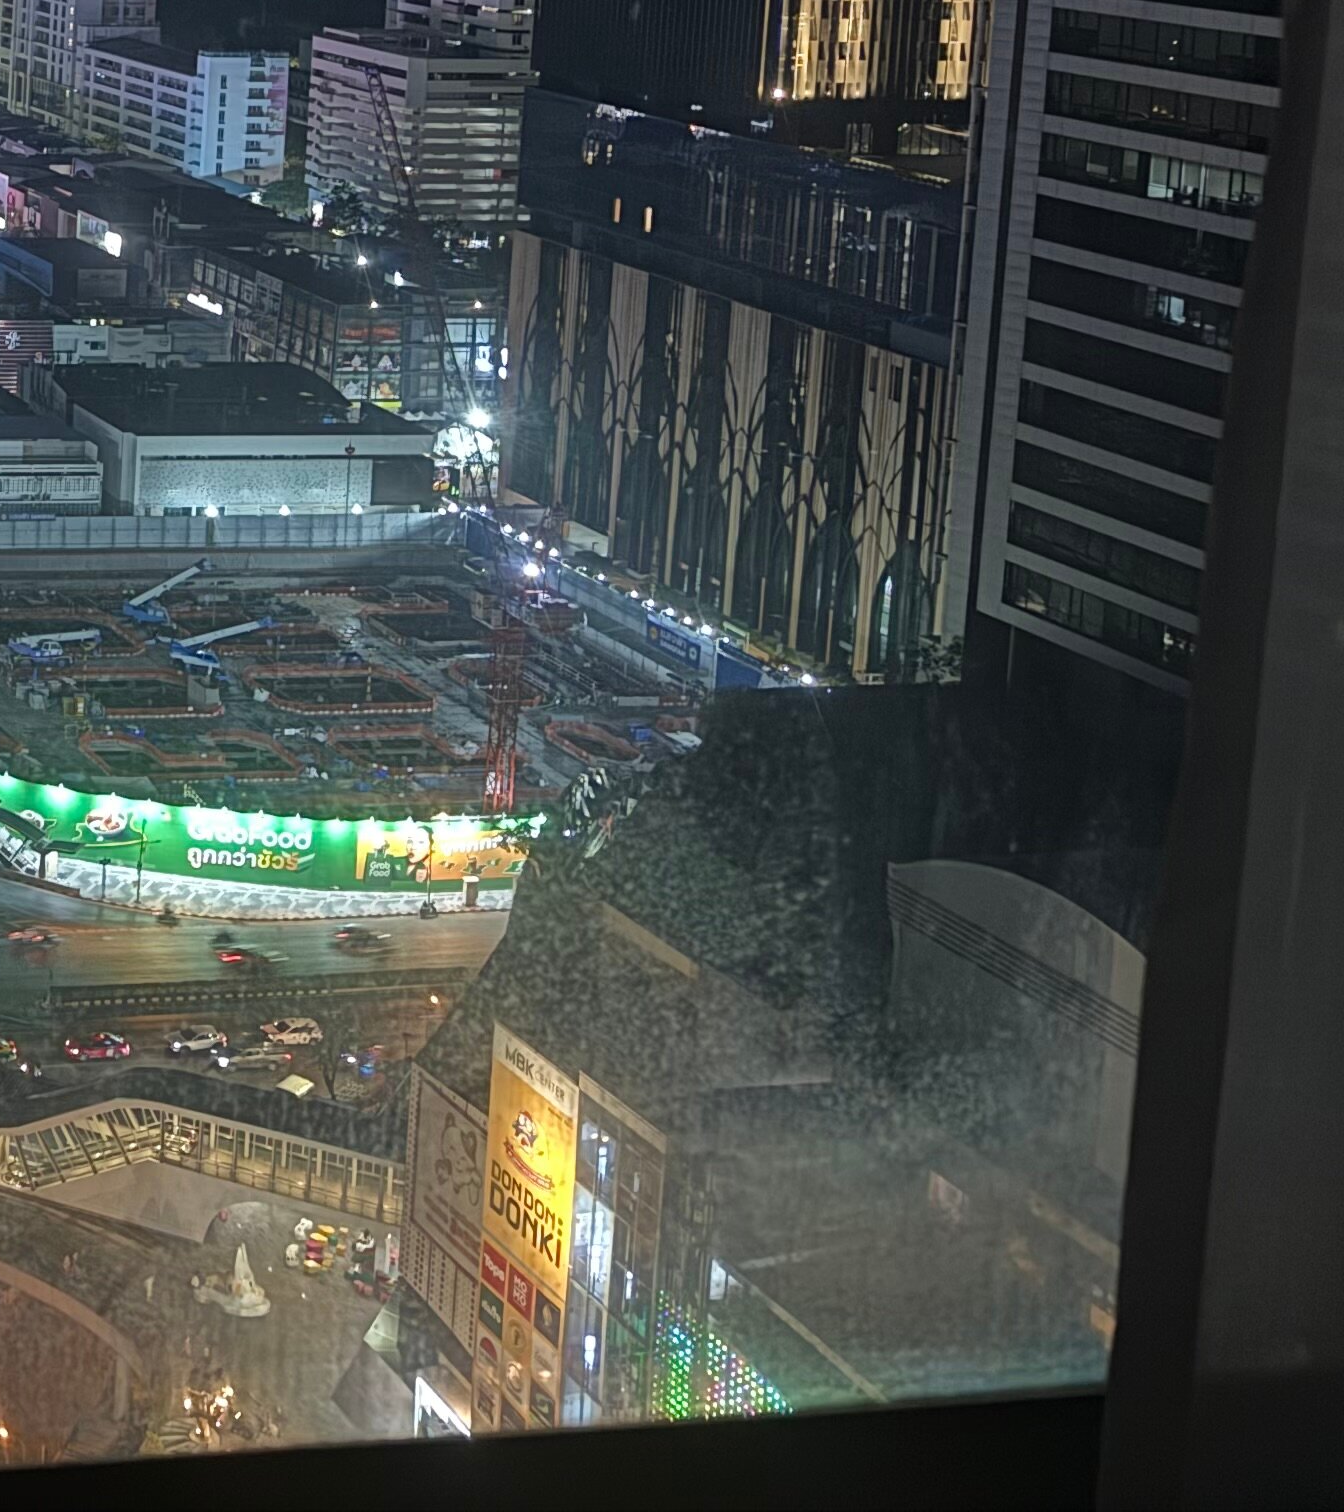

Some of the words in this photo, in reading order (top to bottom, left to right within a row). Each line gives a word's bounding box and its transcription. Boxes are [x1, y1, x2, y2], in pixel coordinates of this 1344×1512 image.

[368, 868, 390, 878] Food
[369, 860, 391, 870] Grab
[505, 1042, 535, 1080] MBK
[492, 1159, 522, 1202] DON
[524, 1187, 556, 1231] DON
